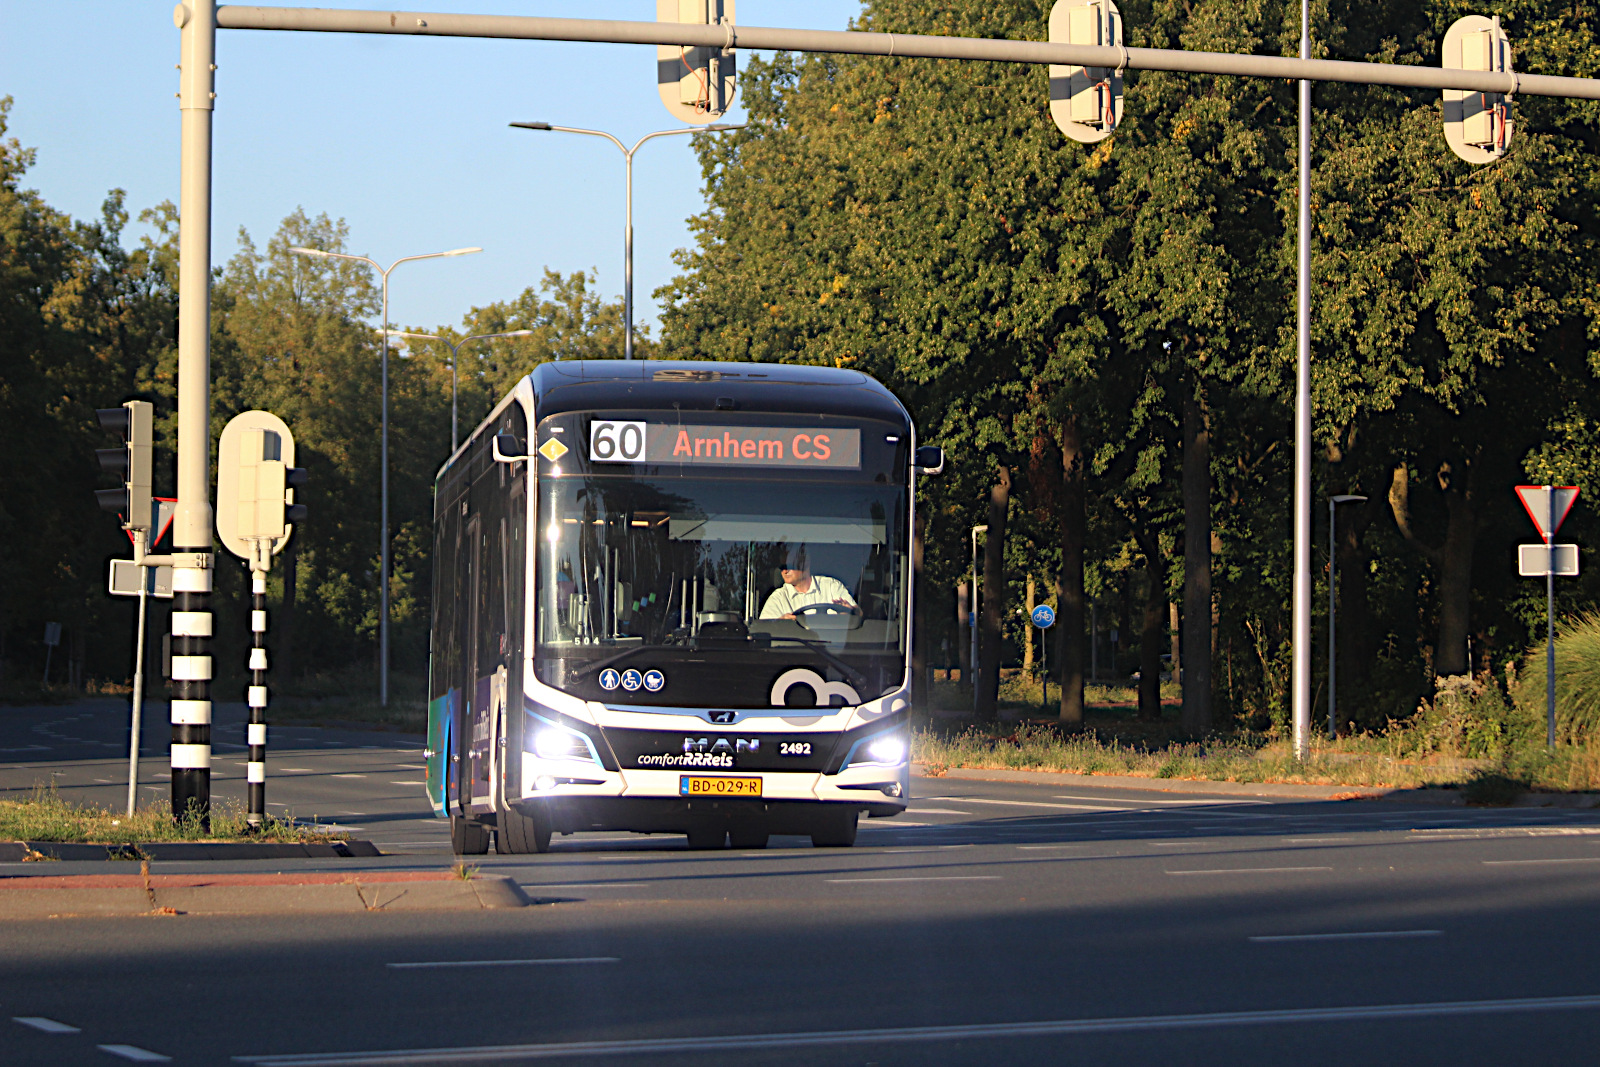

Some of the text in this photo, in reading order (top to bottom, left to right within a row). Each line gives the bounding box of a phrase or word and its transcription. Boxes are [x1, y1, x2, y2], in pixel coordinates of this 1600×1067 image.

[592, 423, 831, 460] 60 Arnhem CS
[684, 737, 760, 753] MAN
[780, 742, 811, 754] 2492
[692, 780, 757, 792] BD-029-R
